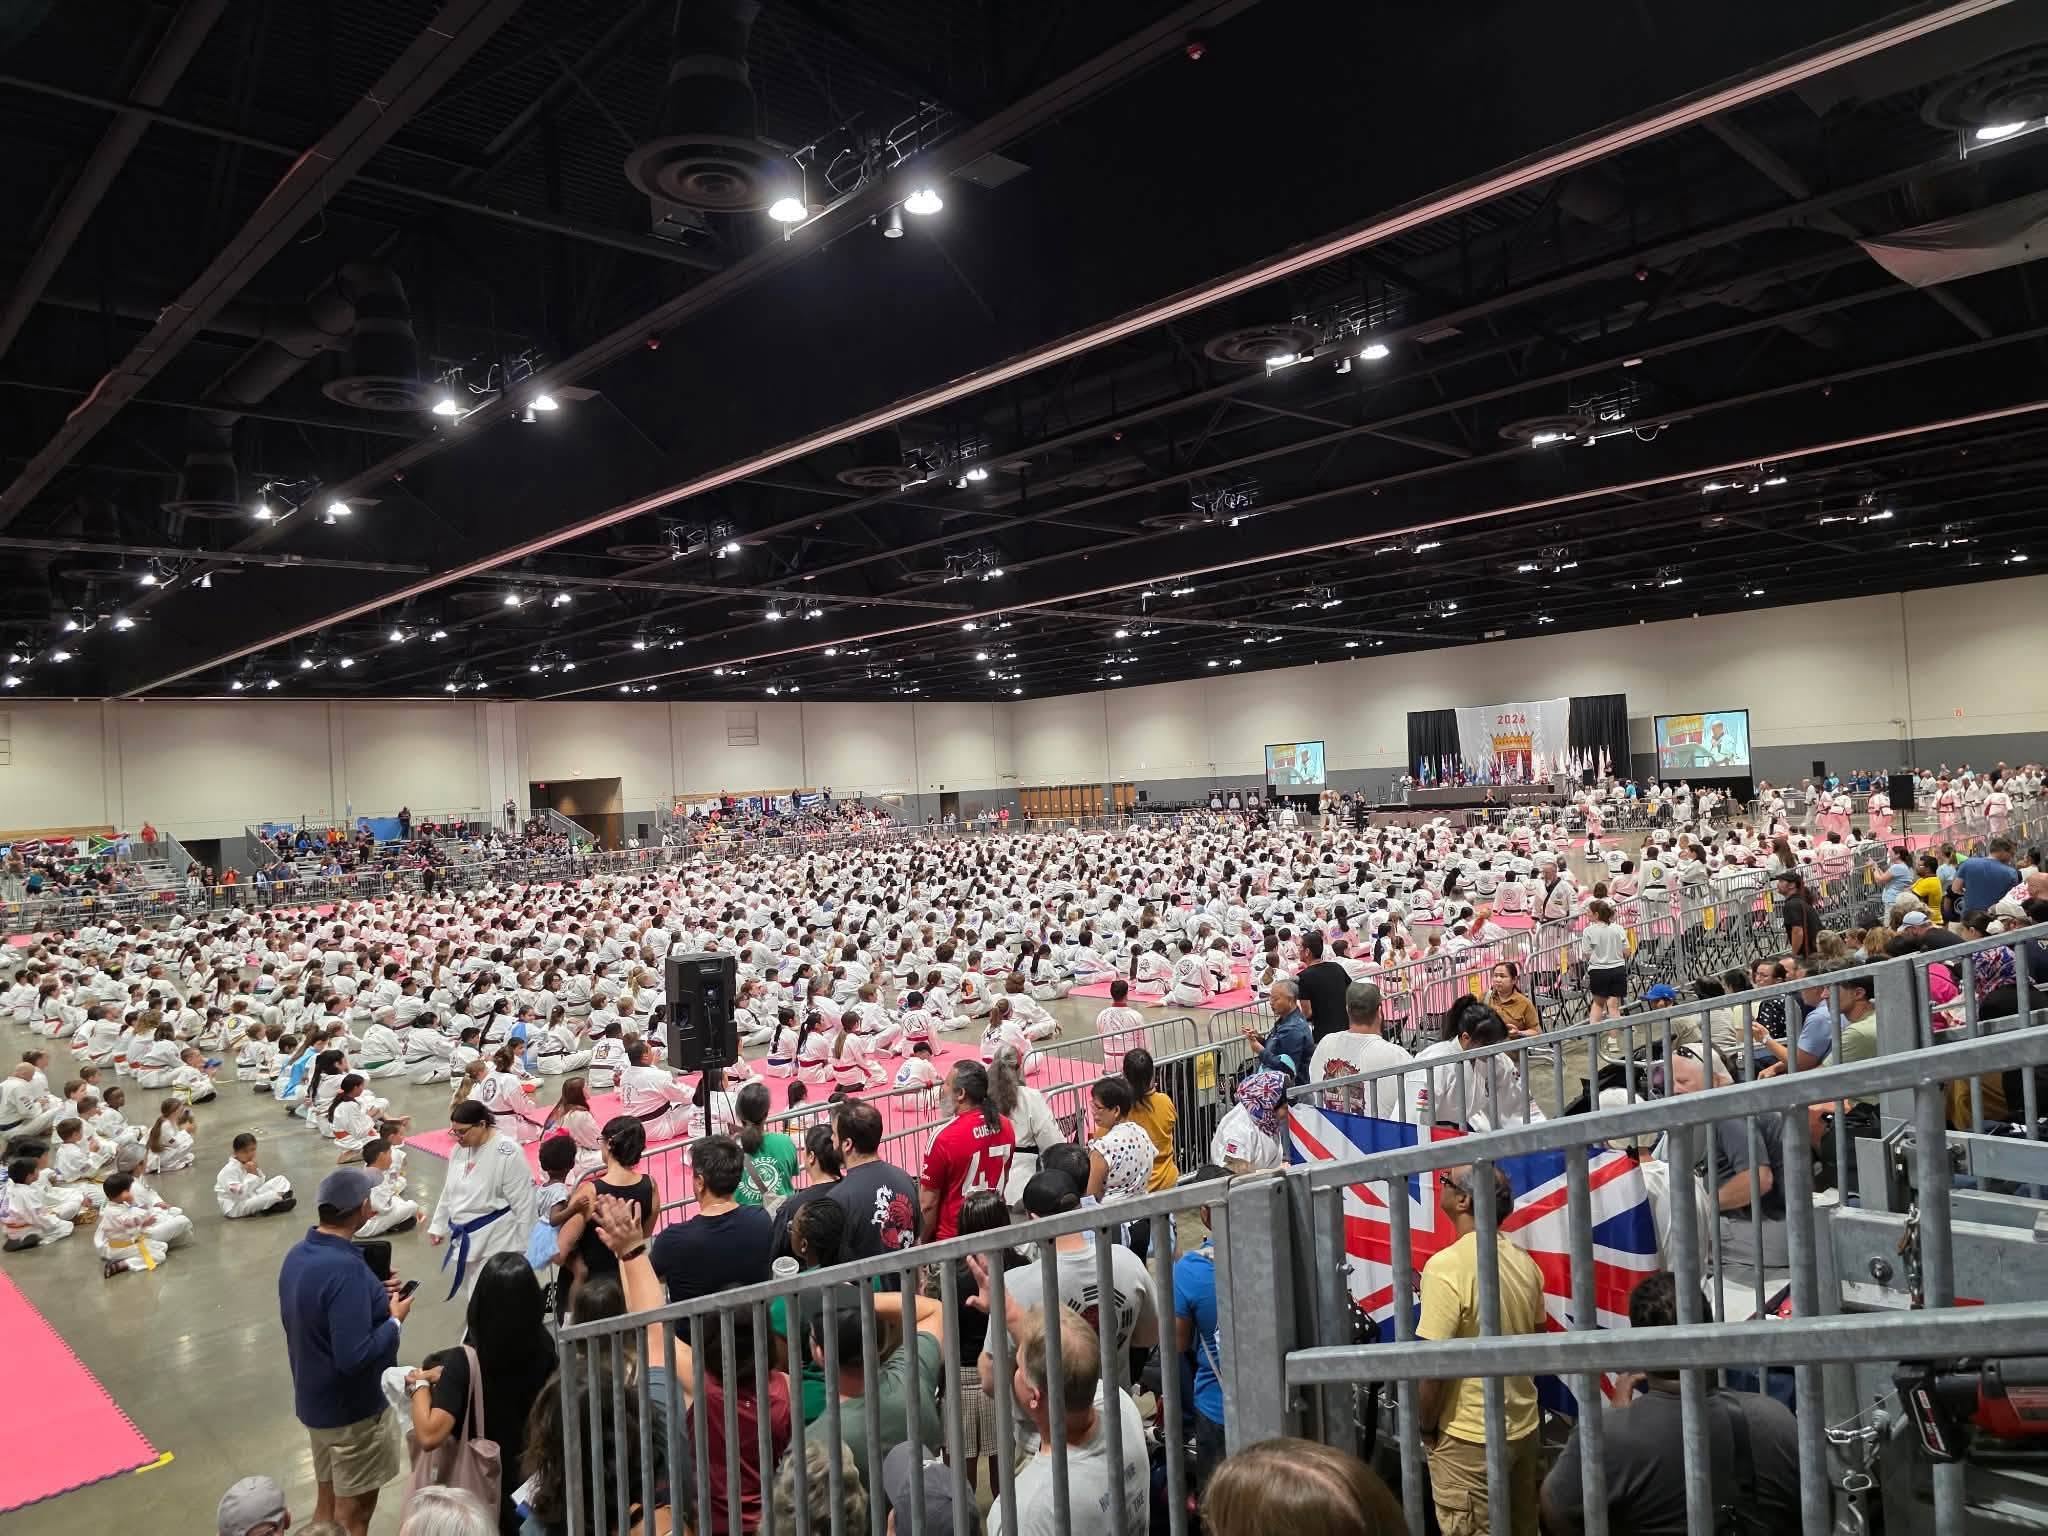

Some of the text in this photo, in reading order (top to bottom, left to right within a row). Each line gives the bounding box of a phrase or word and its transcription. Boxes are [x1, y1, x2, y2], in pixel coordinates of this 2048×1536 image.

[1497, 714, 1526, 725] 2026
[961, 1144, 1012, 1196] 47
[738, 1181, 762, 1201] MARTI
